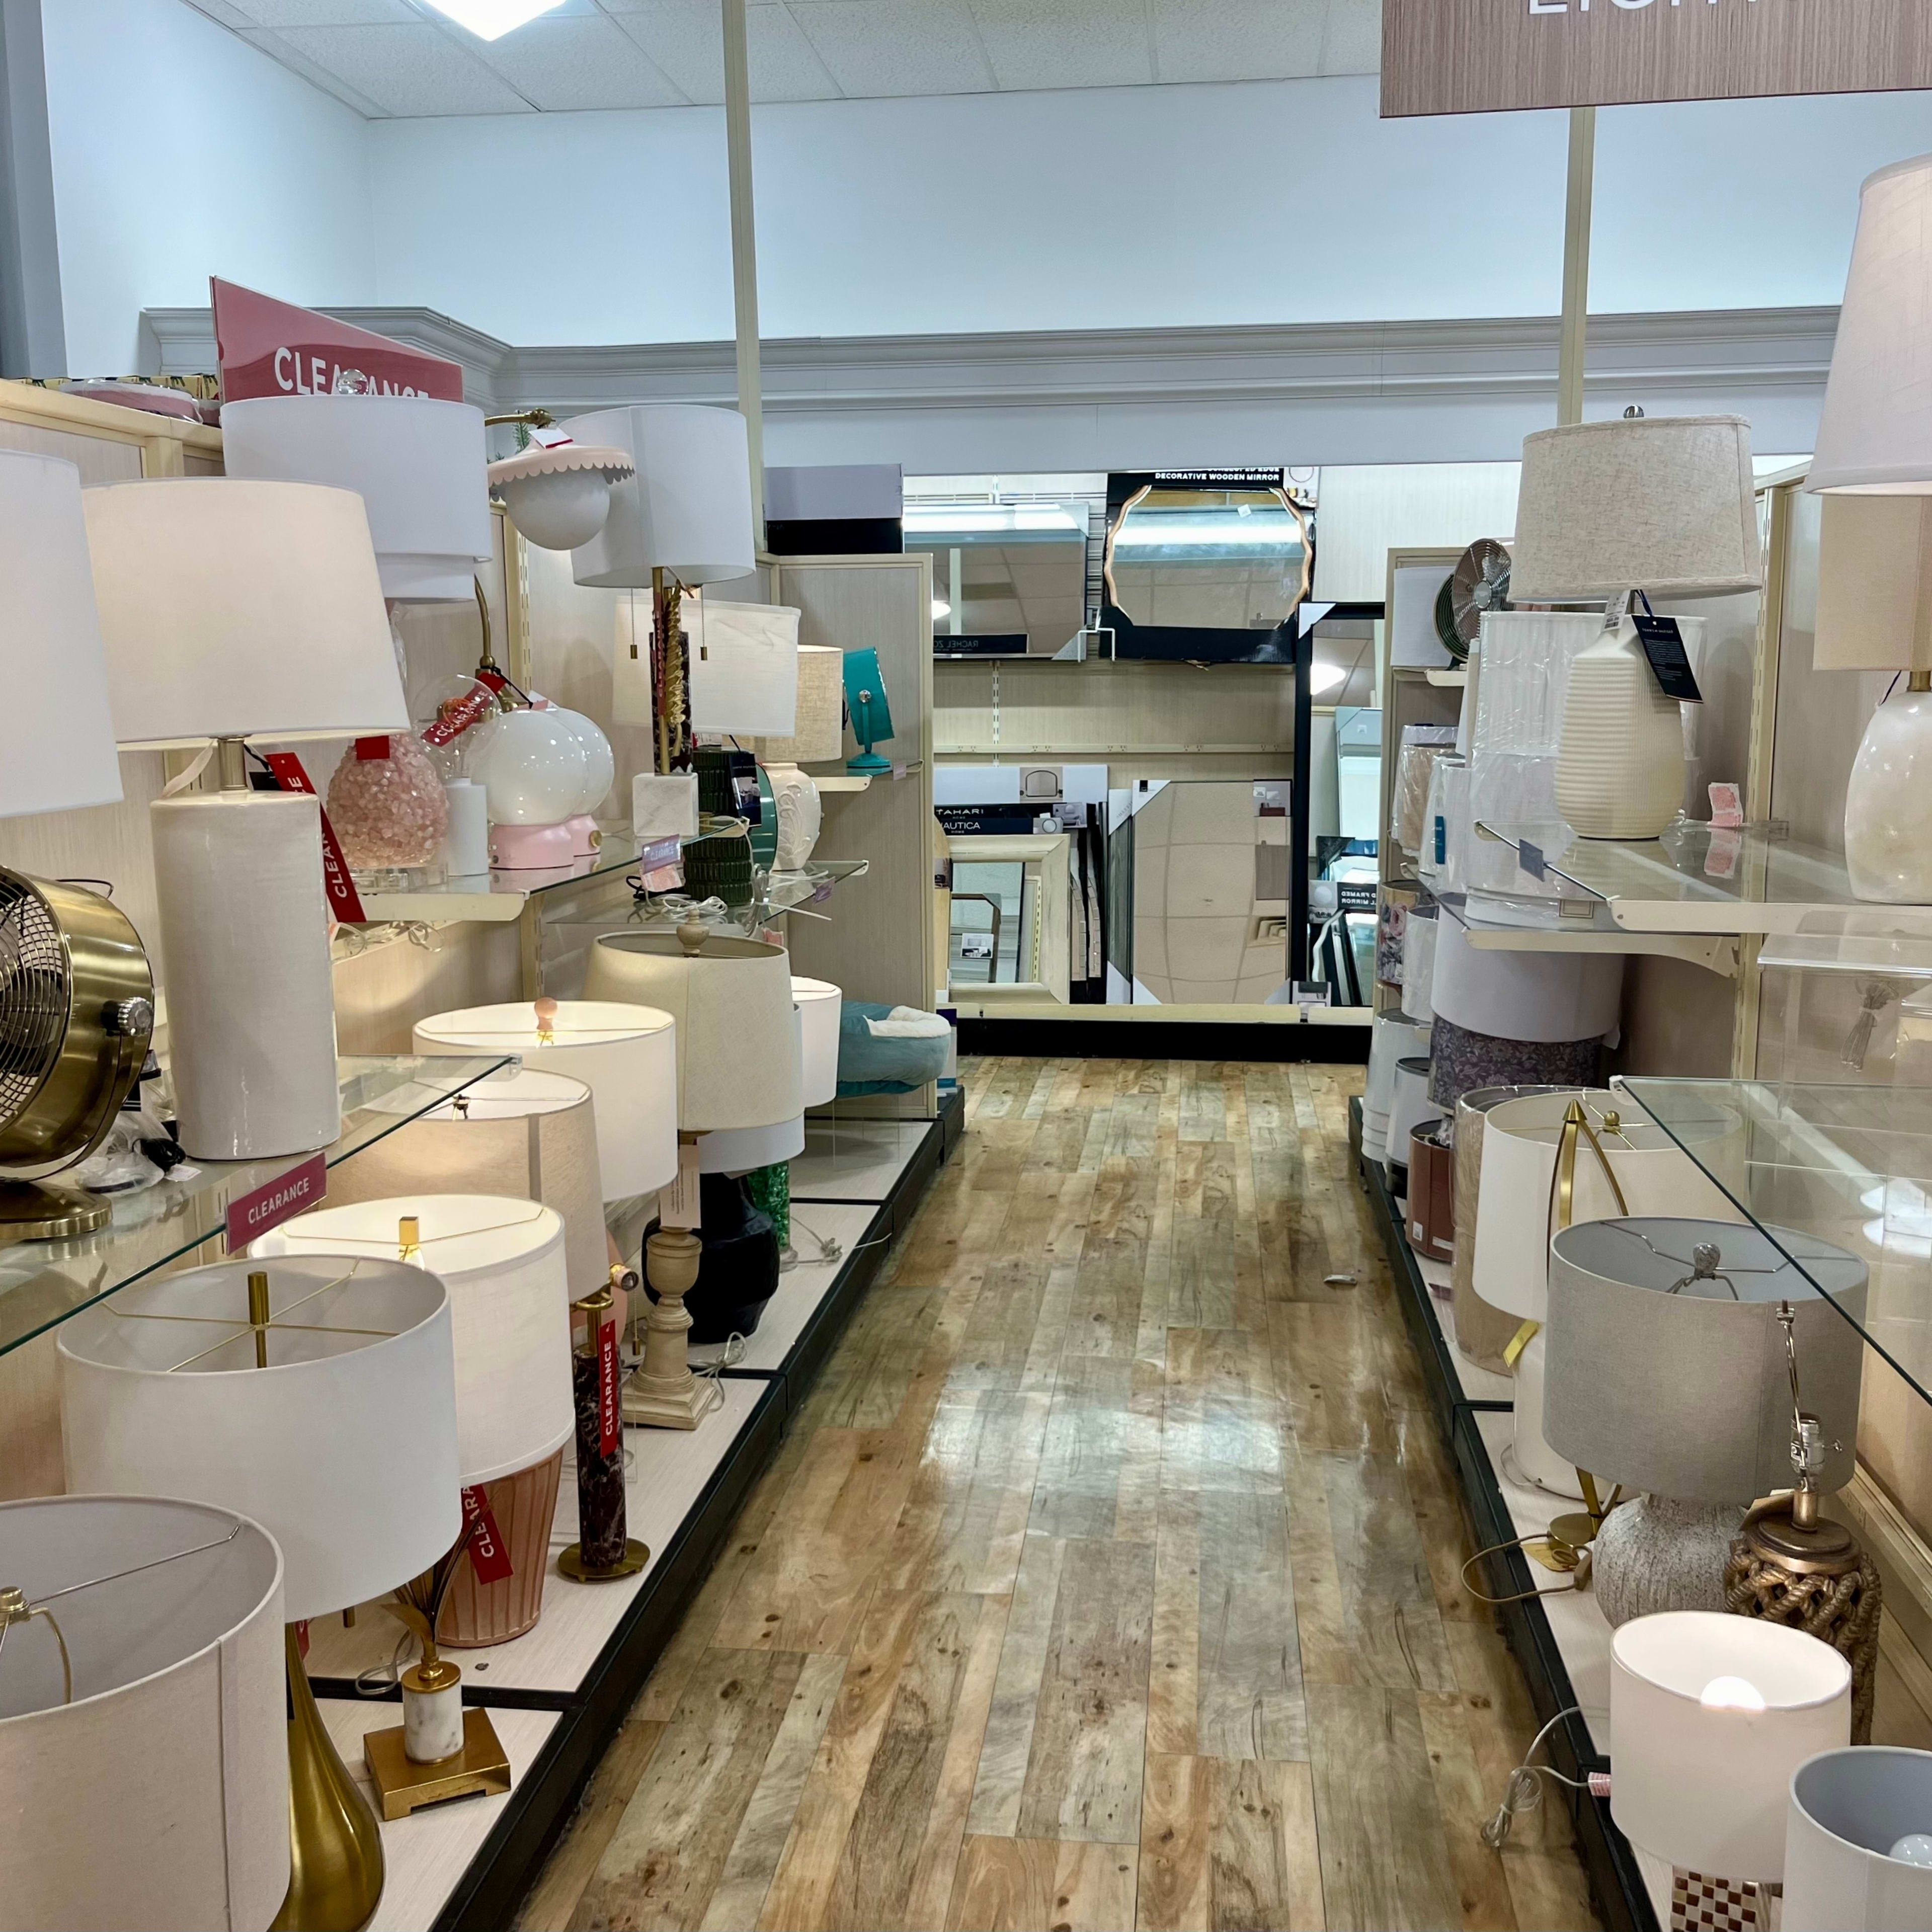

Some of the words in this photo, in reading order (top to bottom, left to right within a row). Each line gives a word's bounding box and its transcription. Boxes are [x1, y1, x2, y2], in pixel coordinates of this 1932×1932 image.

[941, 822, 981, 830] AUTICA
[248, 1177, 310, 1225] CLEARANCE
[604, 1341, 613, 1436] CLEARANCE
